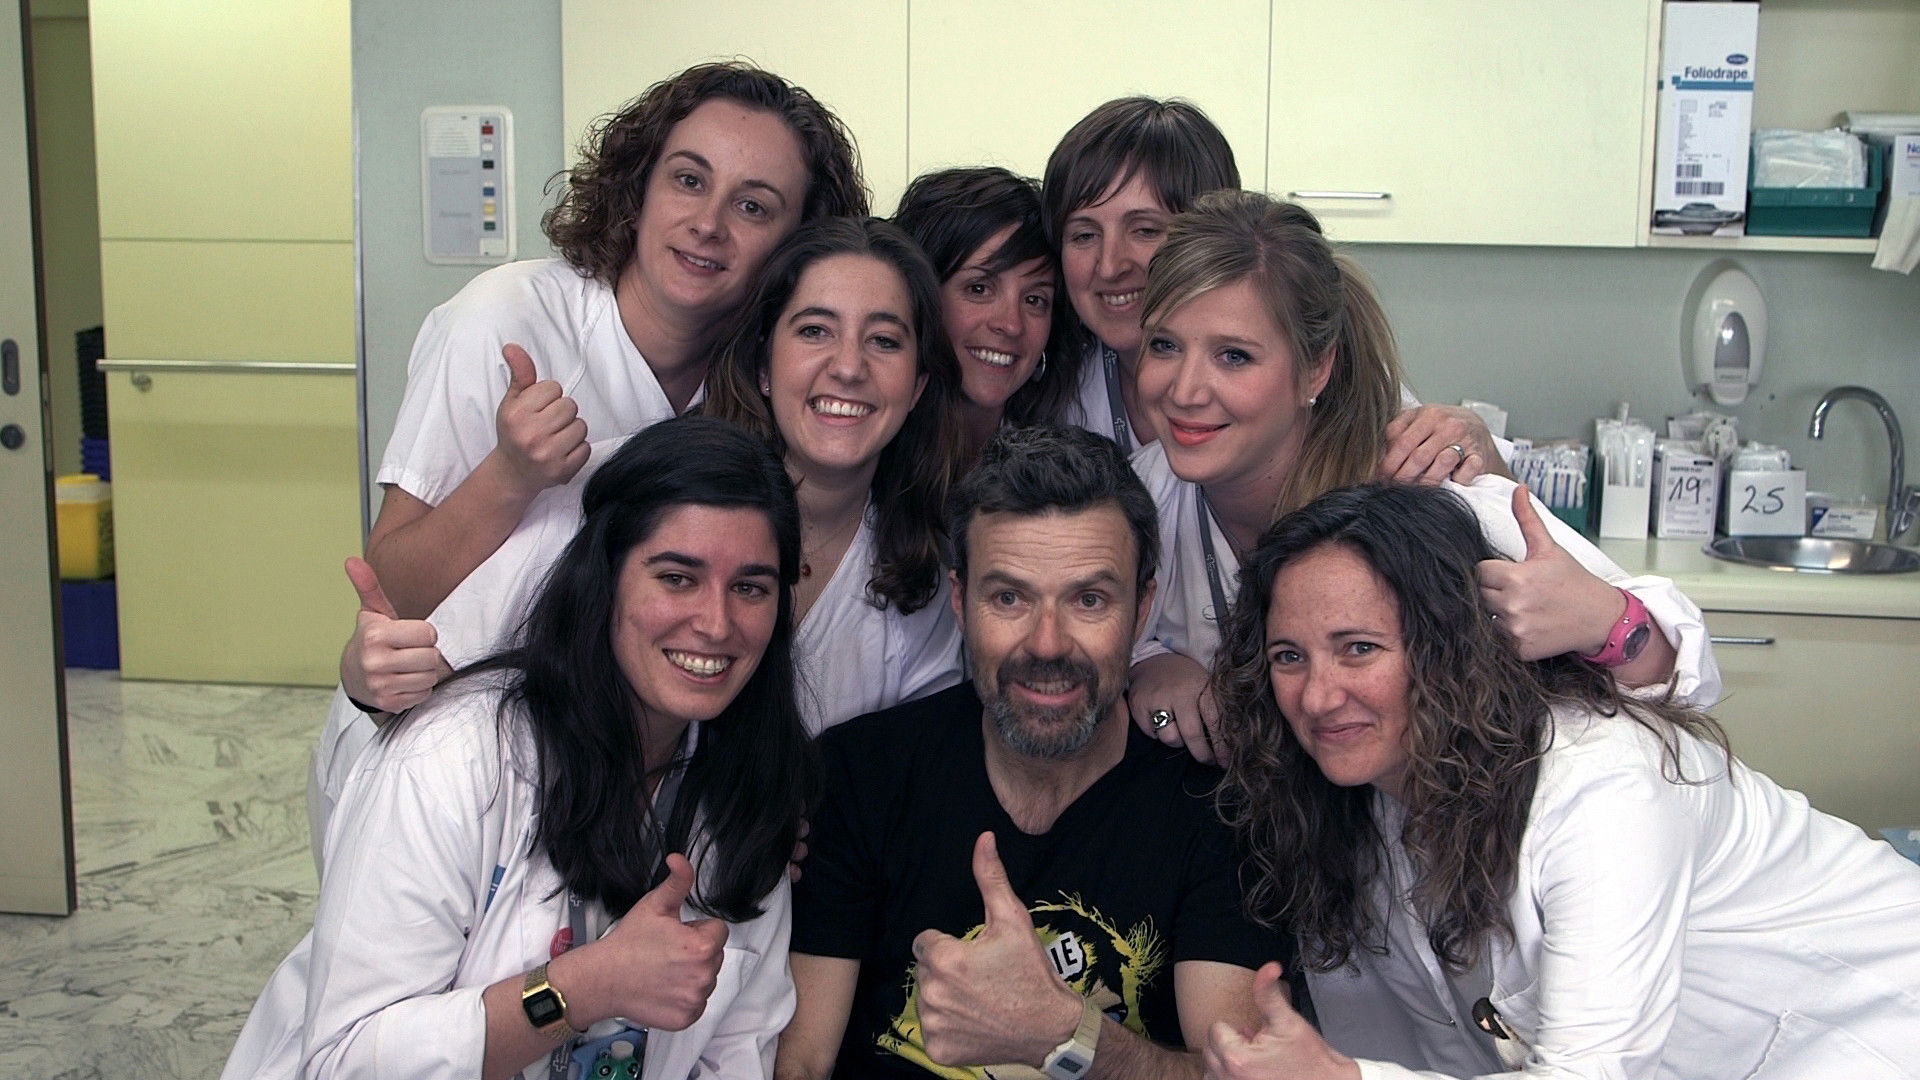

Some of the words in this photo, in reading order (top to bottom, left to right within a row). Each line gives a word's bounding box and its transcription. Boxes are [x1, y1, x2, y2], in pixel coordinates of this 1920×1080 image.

[1684, 65, 1748, 84] Foliodrape
[1669, 475, 1700, 504] 19
[1741, 485, 1785, 515] 25
